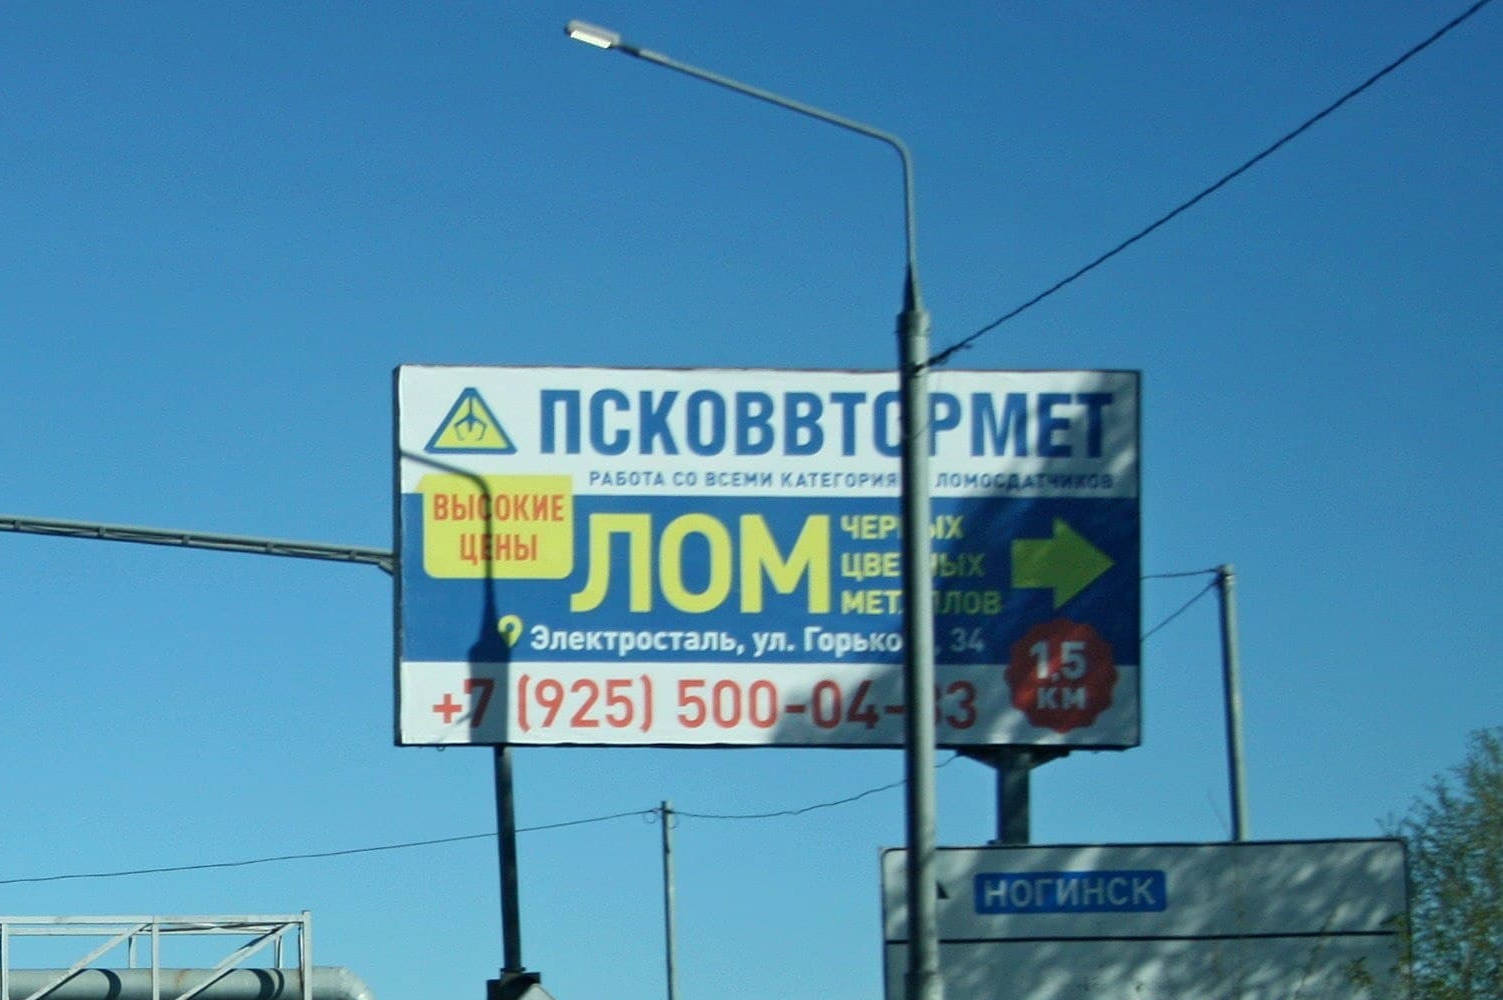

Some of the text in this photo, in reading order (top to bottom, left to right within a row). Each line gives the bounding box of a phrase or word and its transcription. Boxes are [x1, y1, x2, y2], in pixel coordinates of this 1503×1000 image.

[540, 388, 1114, 458] ПСКОВВТОРМЕТ
[589, 470, 1114, 490] РАБОТА СО ВСЕМИ КАТЕГОРИЯ ЛОМОСДАТЧИКОВ
[433, 493, 565, 522] ВЫСОКИЕ
[840, 514, 964, 540] ЧЕРЫХ
[460, 533, 538, 566] ЦЕНЫ
[570, 512, 831, 614] ЛОМ
[840, 552, 986, 582] ЦВЕЫХ
[840, 590, 1002, 615] МЕТЛОВ
[530, 624, 986, 658] Электросталь, ул. Горько, 34
[1029, 640, 1087, 682] 1,5
[432, 674, 978, 734] +7 (925) 500-04-3
[983, 876, 1157, 908] НОГИНСК
